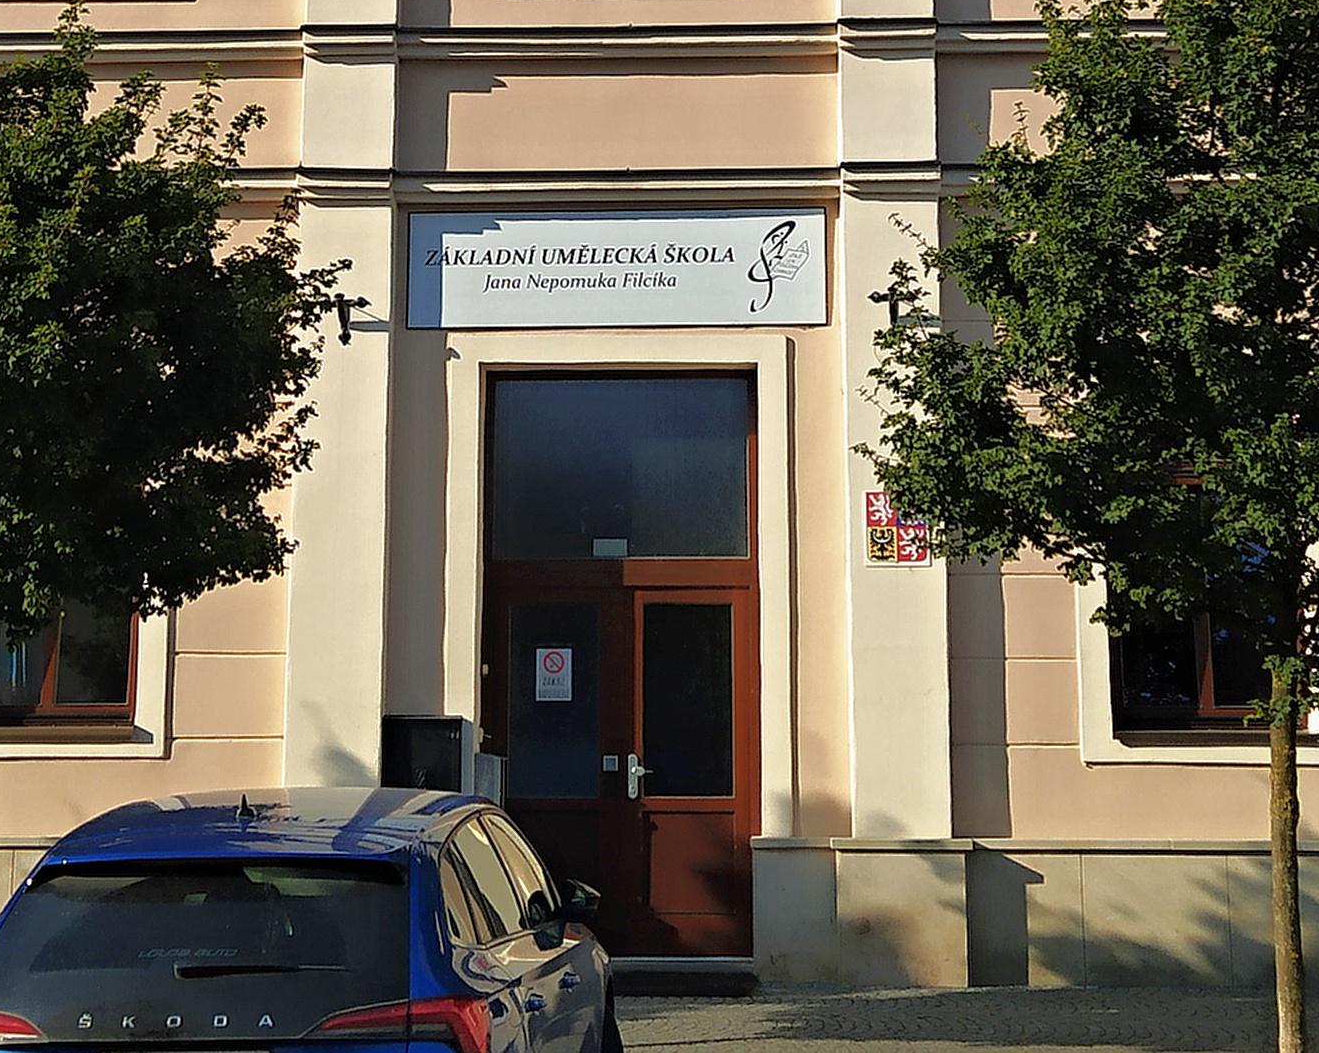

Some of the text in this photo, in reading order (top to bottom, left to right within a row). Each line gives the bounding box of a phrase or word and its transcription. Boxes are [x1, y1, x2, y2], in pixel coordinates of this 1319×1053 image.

[424, 243, 735, 266] ZÁKLADNÍ UMĚLECKÁ ŠKOLA
[482, 271, 678, 293] Jana Nepomuka Filcíka
[77, 1013, 274, 1029] ŠKODA
